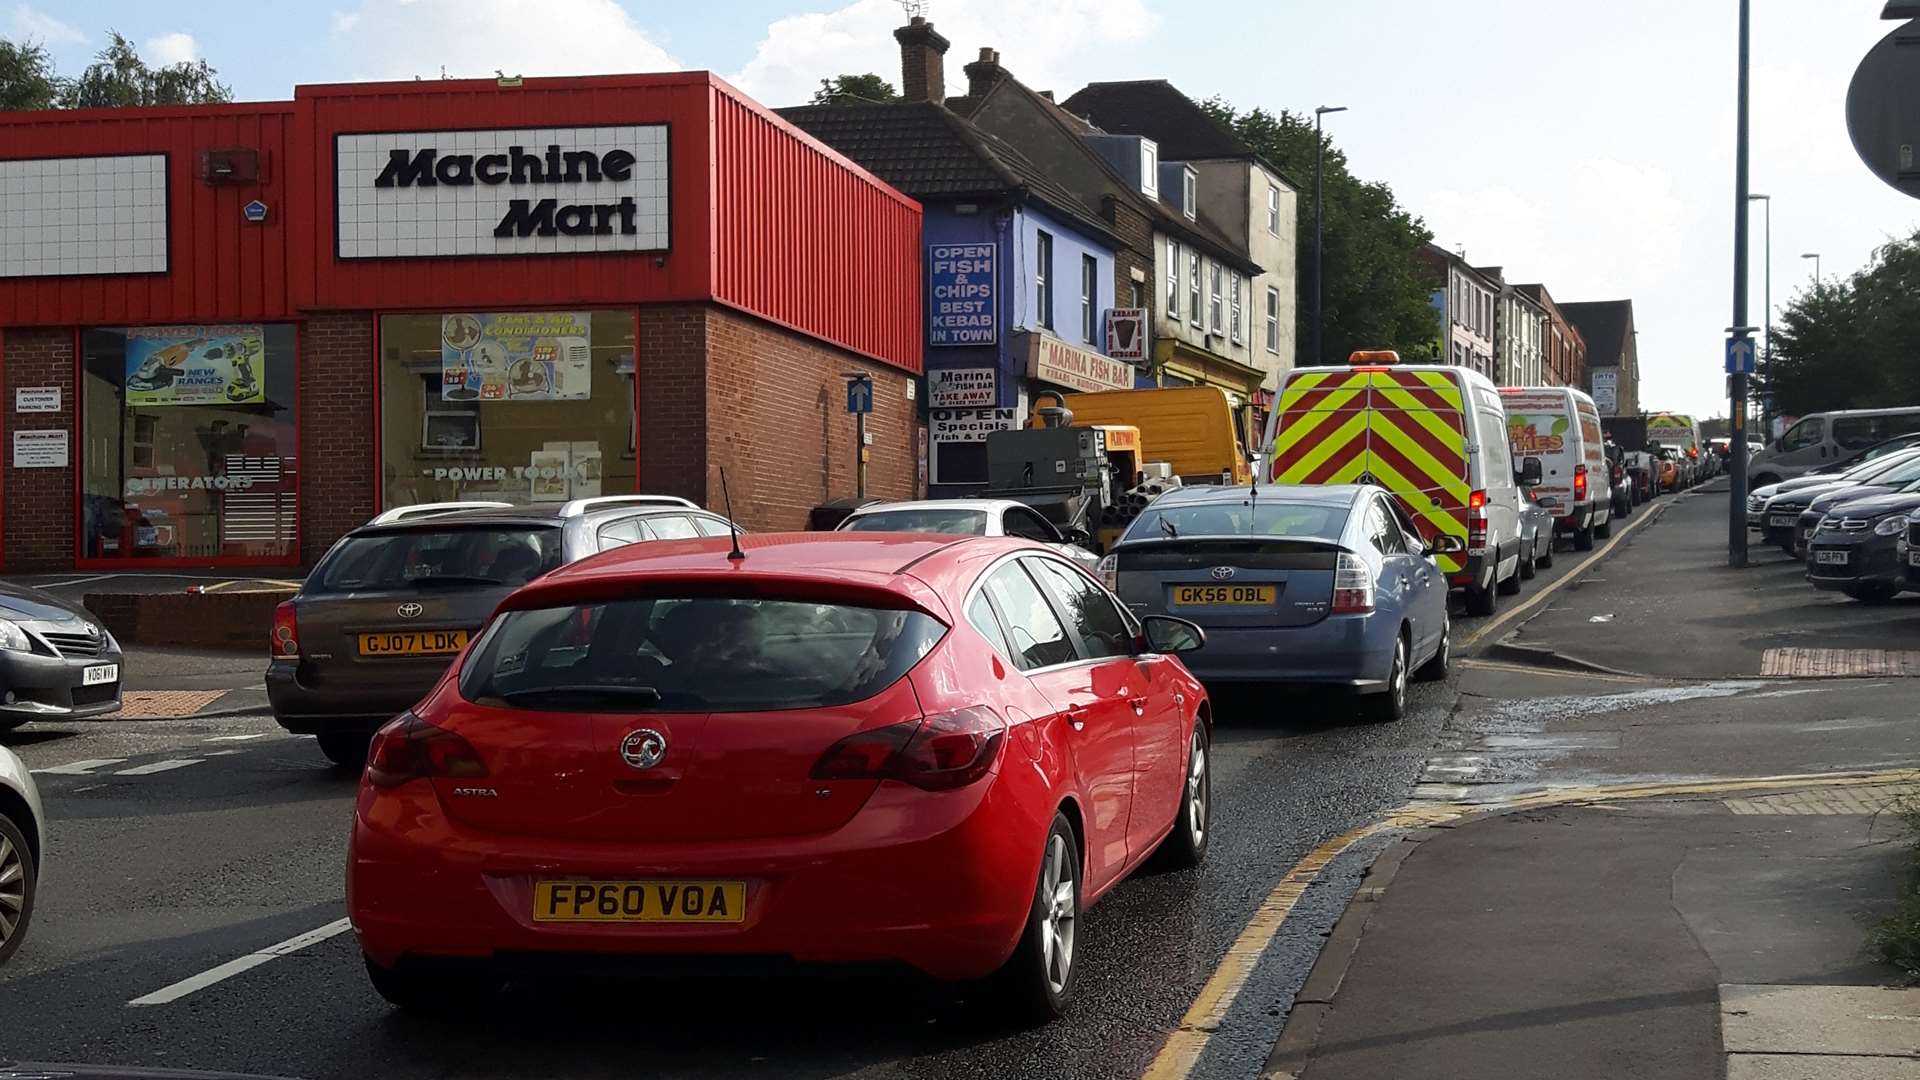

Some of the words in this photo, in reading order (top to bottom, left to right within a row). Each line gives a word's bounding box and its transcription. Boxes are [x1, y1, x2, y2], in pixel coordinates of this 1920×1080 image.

[374, 144, 637, 188] Machine
[493, 196, 637, 238] Mart
[934, 246, 991, 258] OPEN
[934, 260, 991, 274] FISH
[955, 274, 968, 284] &
[934, 284, 991, 298] CHIPS
[940, 301, 985, 313] BEST
[932, 315, 992, 327] KEBAB
[932, 330, 946, 342] IN
[951, 329, 993, 341] TOWN
[1049, 343, 1087, 375] MARINA
[1090, 358, 1109, 380] FISH
[1112, 365, 1129, 387] BAR
[188, 368, 215, 376] NEW
[178, 376, 224, 385] RANGES
[956, 382, 974, 390] FISH
[934, 392, 959, 401] TAKE
[963, 391, 992, 400] AWAY
[933, 409, 1014, 421] OPEN
[937, 421, 1009, 432] Specials
[934, 433, 959, 441] Fish
[434, 466, 507, 481] POWER
[1181, 588, 1227, 602] GK56
[1232, 588, 1266, 601] OBL
[367, 635, 415, 652] GJ07
[421, 633, 459, 650] LDK
[453, 788, 498, 797] ASTRA
[550, 885, 645, 915] FP60
[658, 885, 728, 916] VOA
